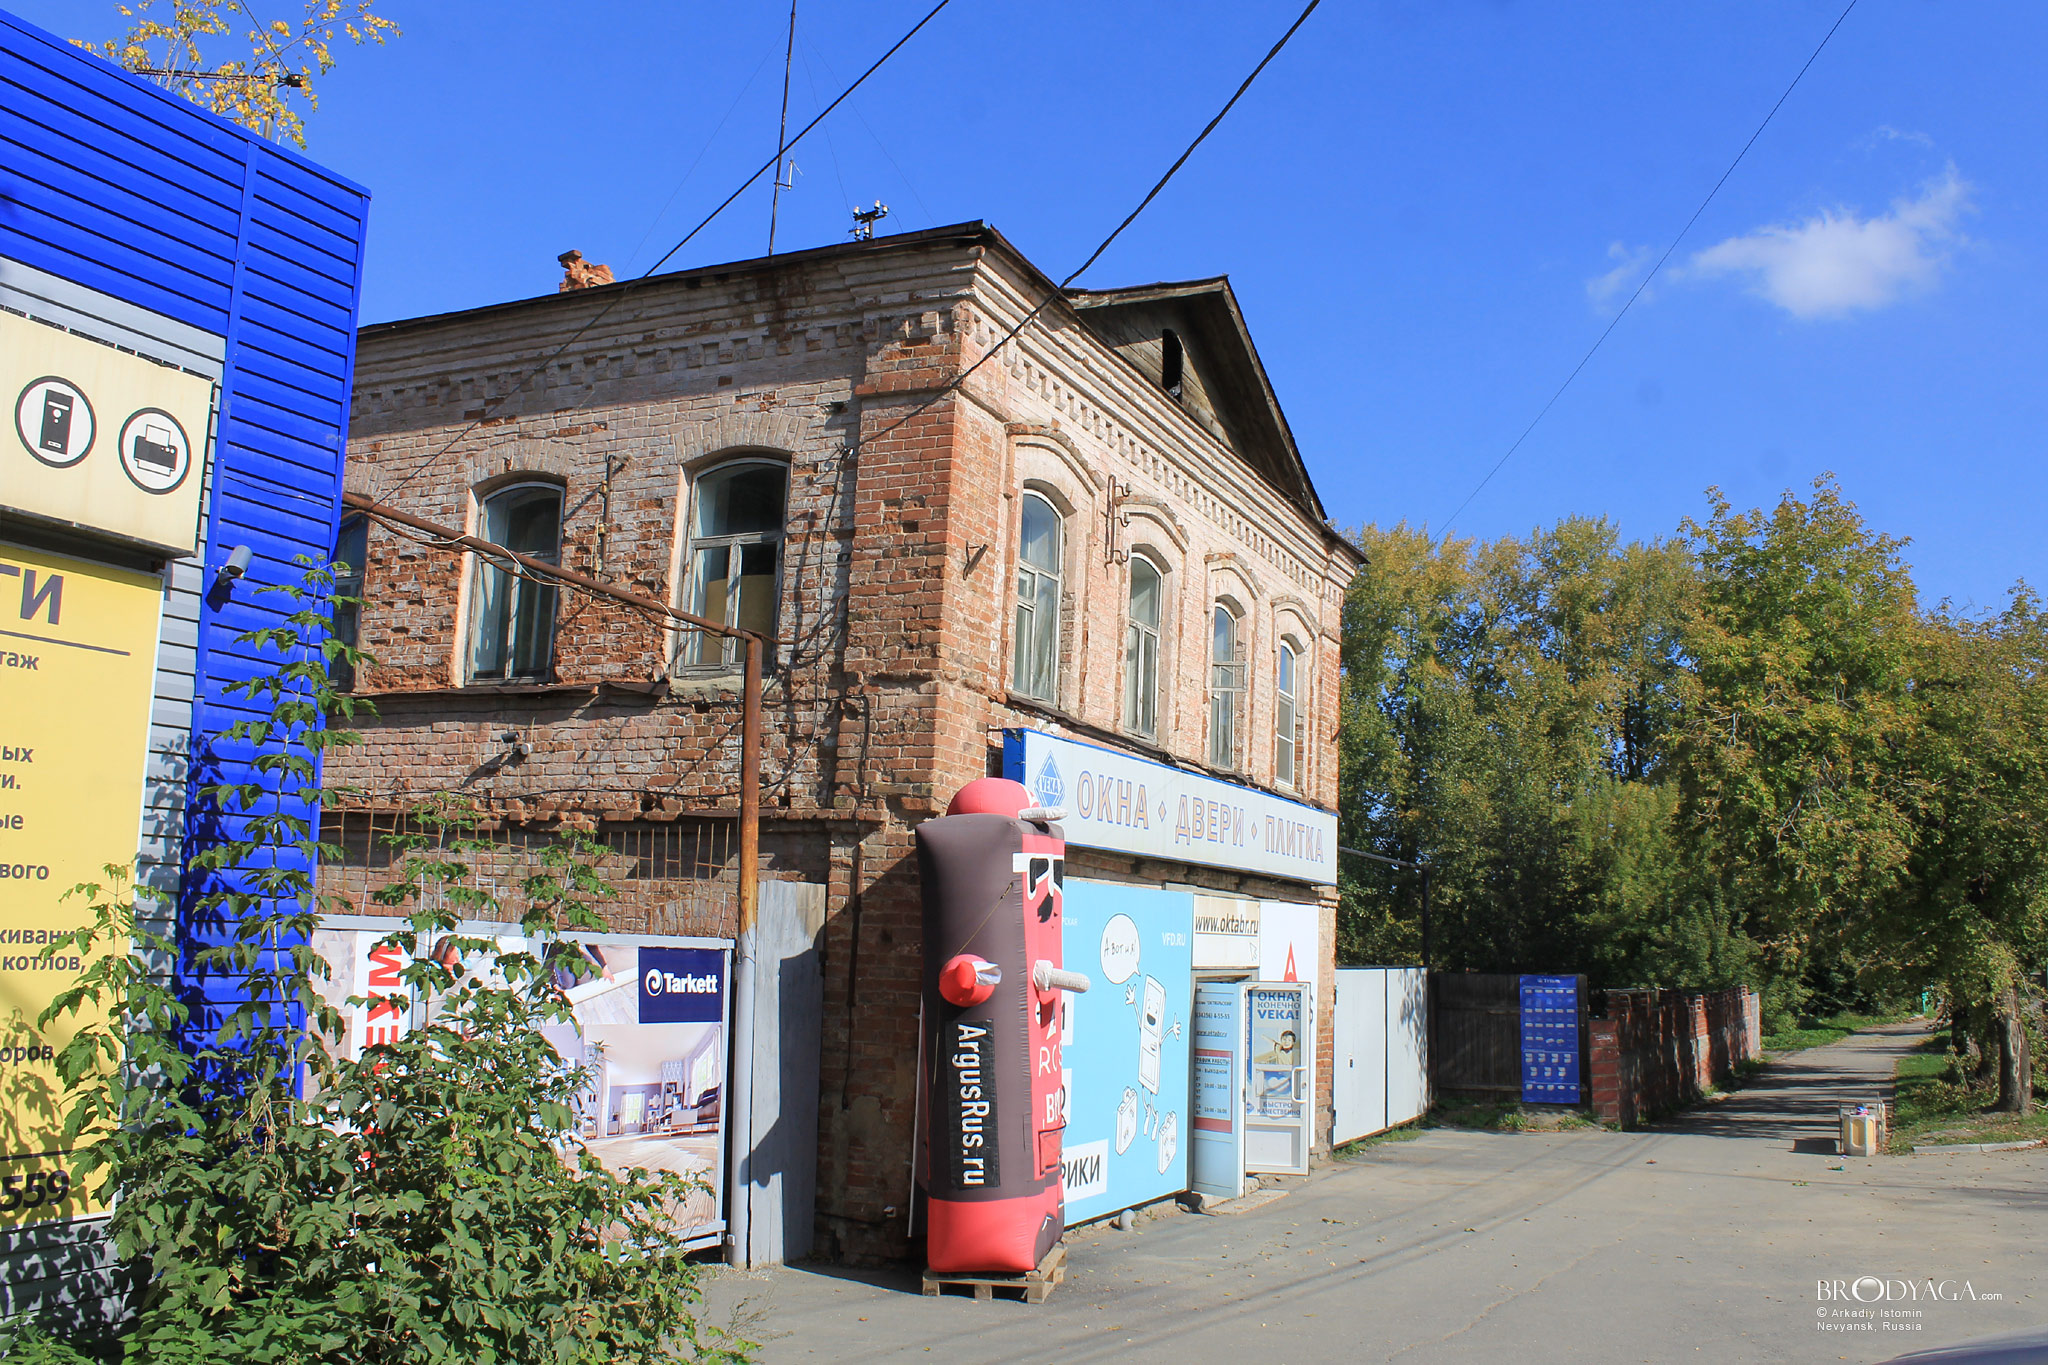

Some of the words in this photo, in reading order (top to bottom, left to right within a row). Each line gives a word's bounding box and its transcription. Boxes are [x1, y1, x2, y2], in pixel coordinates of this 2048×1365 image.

[0, 746, 34, 763] ых
[0, 774, 21, 789] и.
[1041, 776, 1060, 794] VEKA
[1077, 770, 1149, 830] ОКНА
[1175, 794, 1245, 848] ДВЕРИ
[1265, 815, 1324, 864] ПЛИТКА
[1195, 912, 1259, 935] www.oktabr.ru
[1162, 931, 1186, 946] VFD.RU
[3, 955, 86, 974] котлов,
[664, 973, 718, 994] Tarkett
[1257, 991, 1301, 1001] ОКНА?
[1257, 1010, 1299, 1020] VEKA!
[952, 1023, 990, 1186] ArgusRus.ru
[0, 1169, 70, 1211] 559
